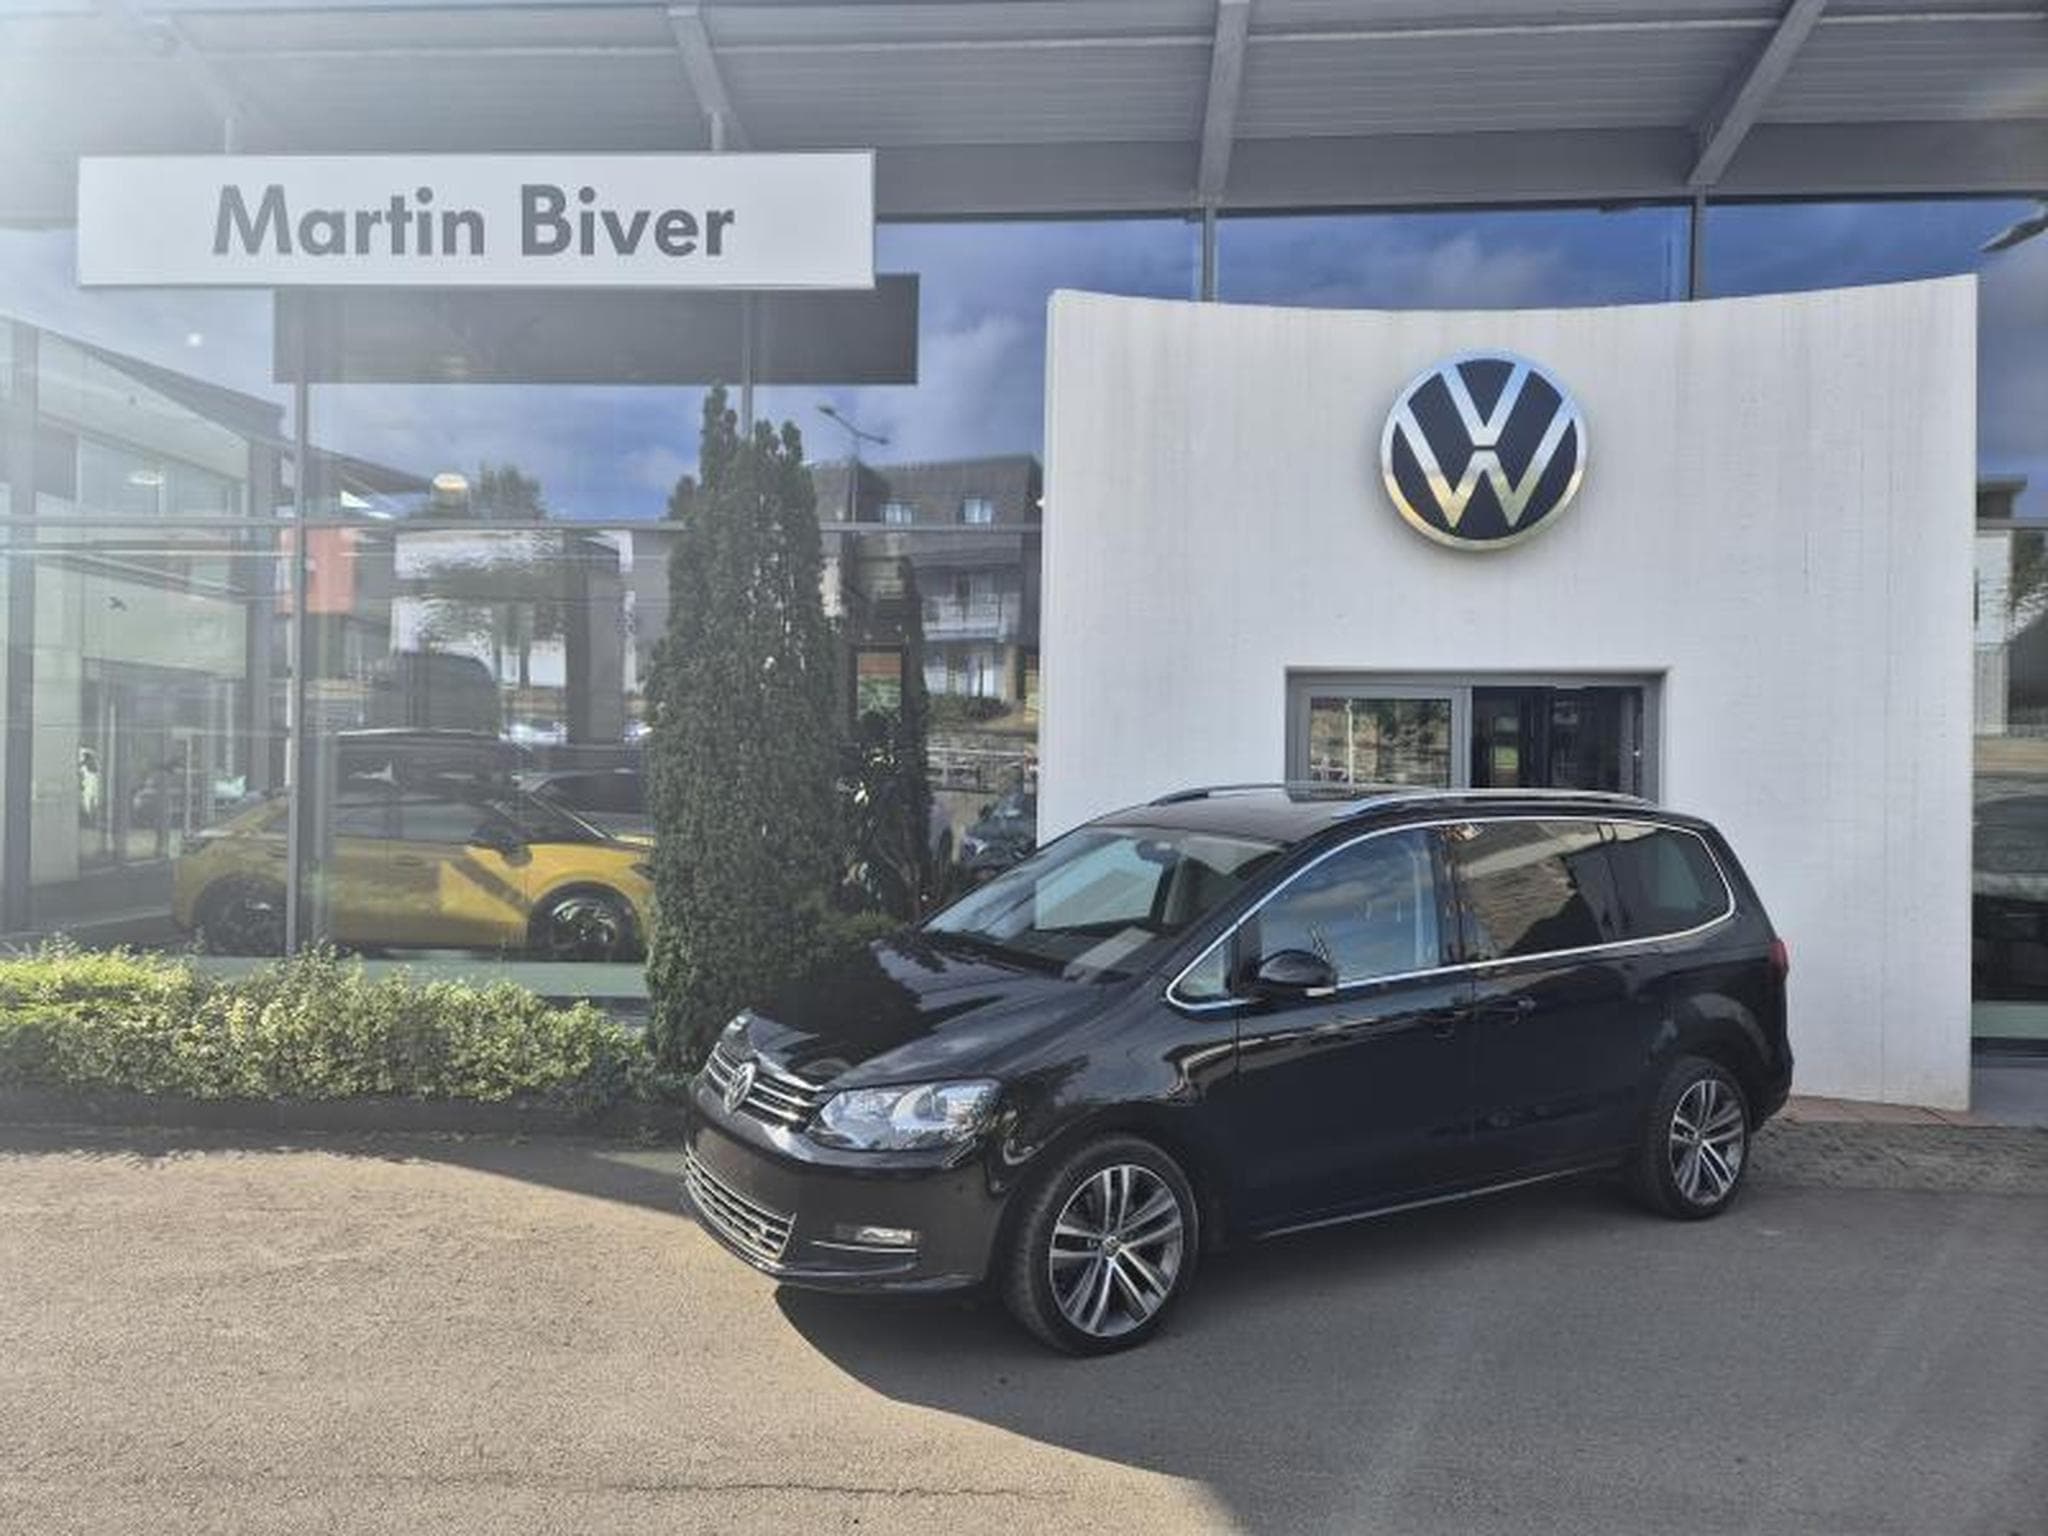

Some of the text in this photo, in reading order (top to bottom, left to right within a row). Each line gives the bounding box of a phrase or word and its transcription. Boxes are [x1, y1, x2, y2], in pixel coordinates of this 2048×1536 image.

[213, 183, 735, 257] Martin Biver
[1388, 354, 1582, 538] VW
